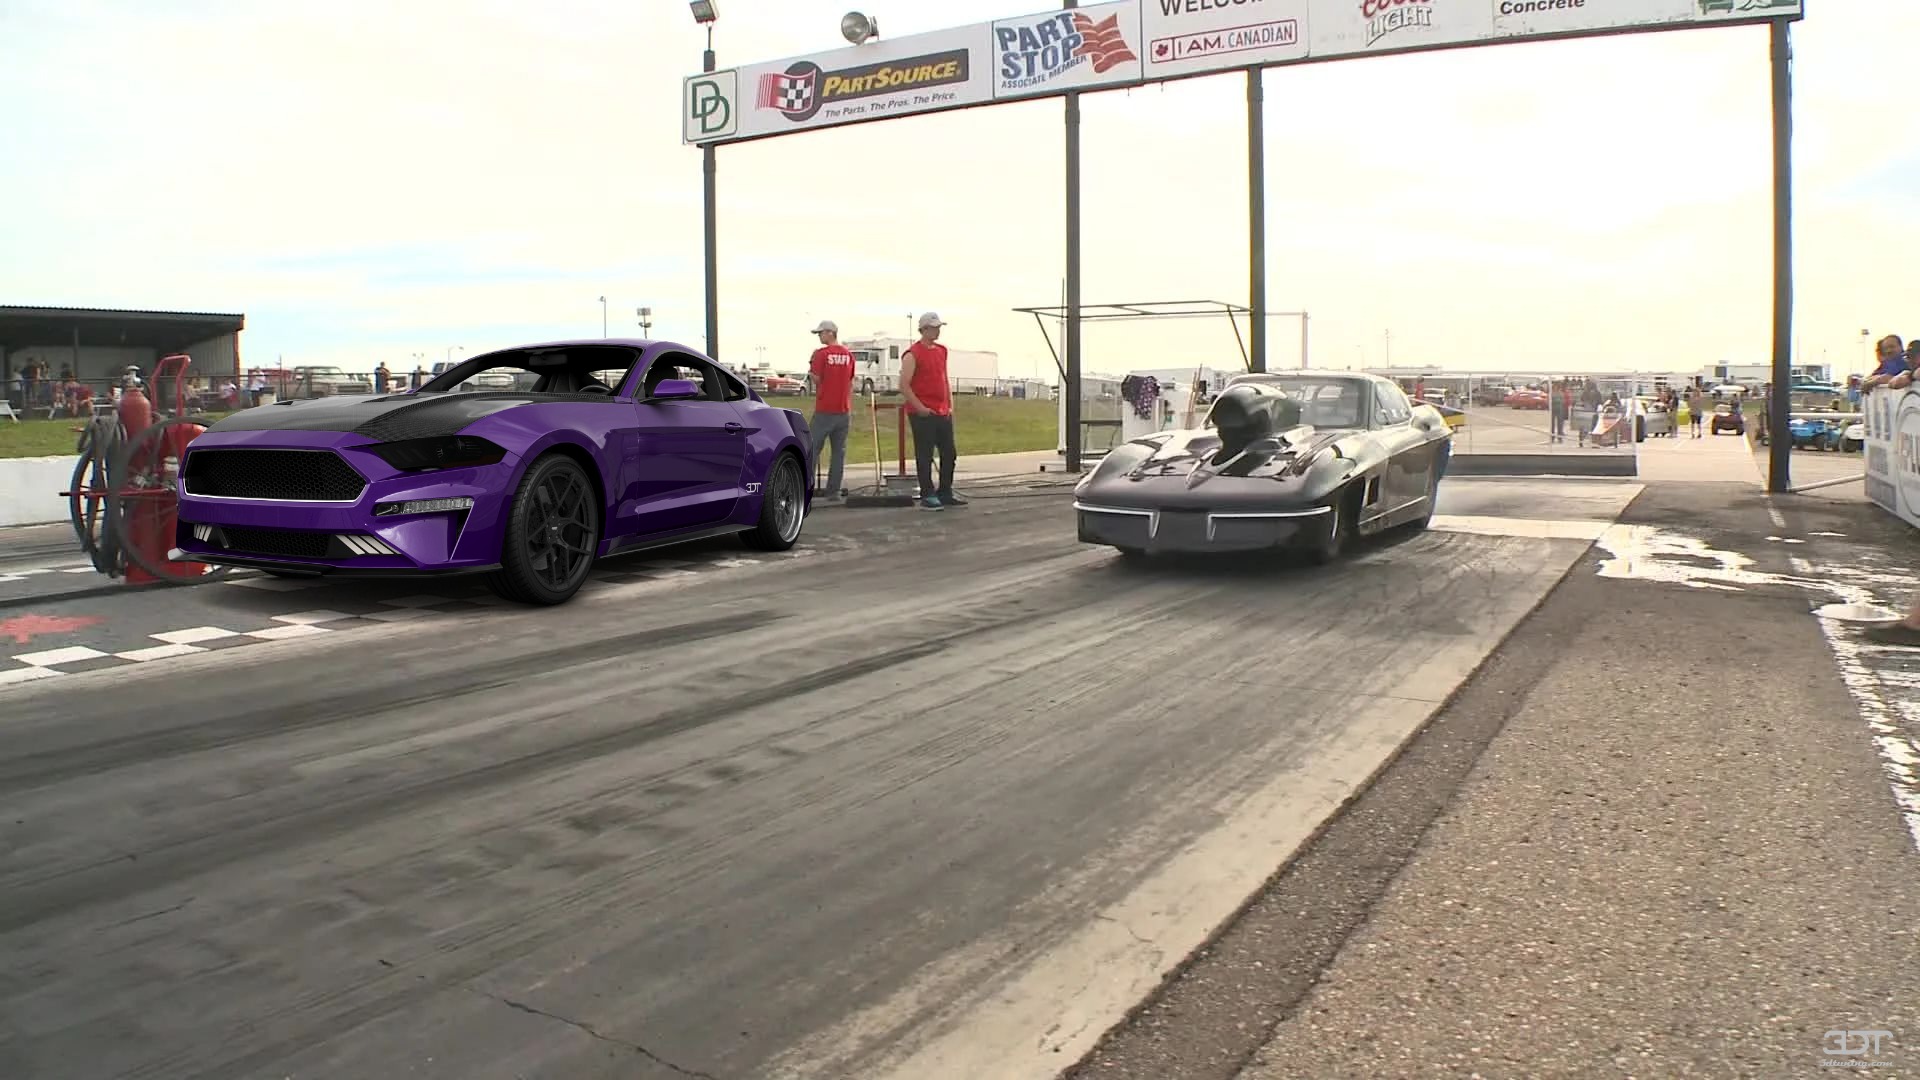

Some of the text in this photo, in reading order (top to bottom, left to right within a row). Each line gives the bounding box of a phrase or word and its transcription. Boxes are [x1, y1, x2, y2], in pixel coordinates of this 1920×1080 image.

[1159, 0, 1263, 17] WEL
[1500, 0, 1585, 15] Concrete
[995, 12, 1075, 51] PART
[1178, 41, 1182, 55] I
[1228, 24, 1293, 48] CANADIAN
[1366, 5, 1433, 47] LIGHT
[1001, 34, 1082, 80] STOP
[1001, 55, 1088, 89] ASSOCIATE MEMBER
[825, 109, 841, 118] The
[870, 102, 886, 112] The
[913, 96, 930, 105] The
